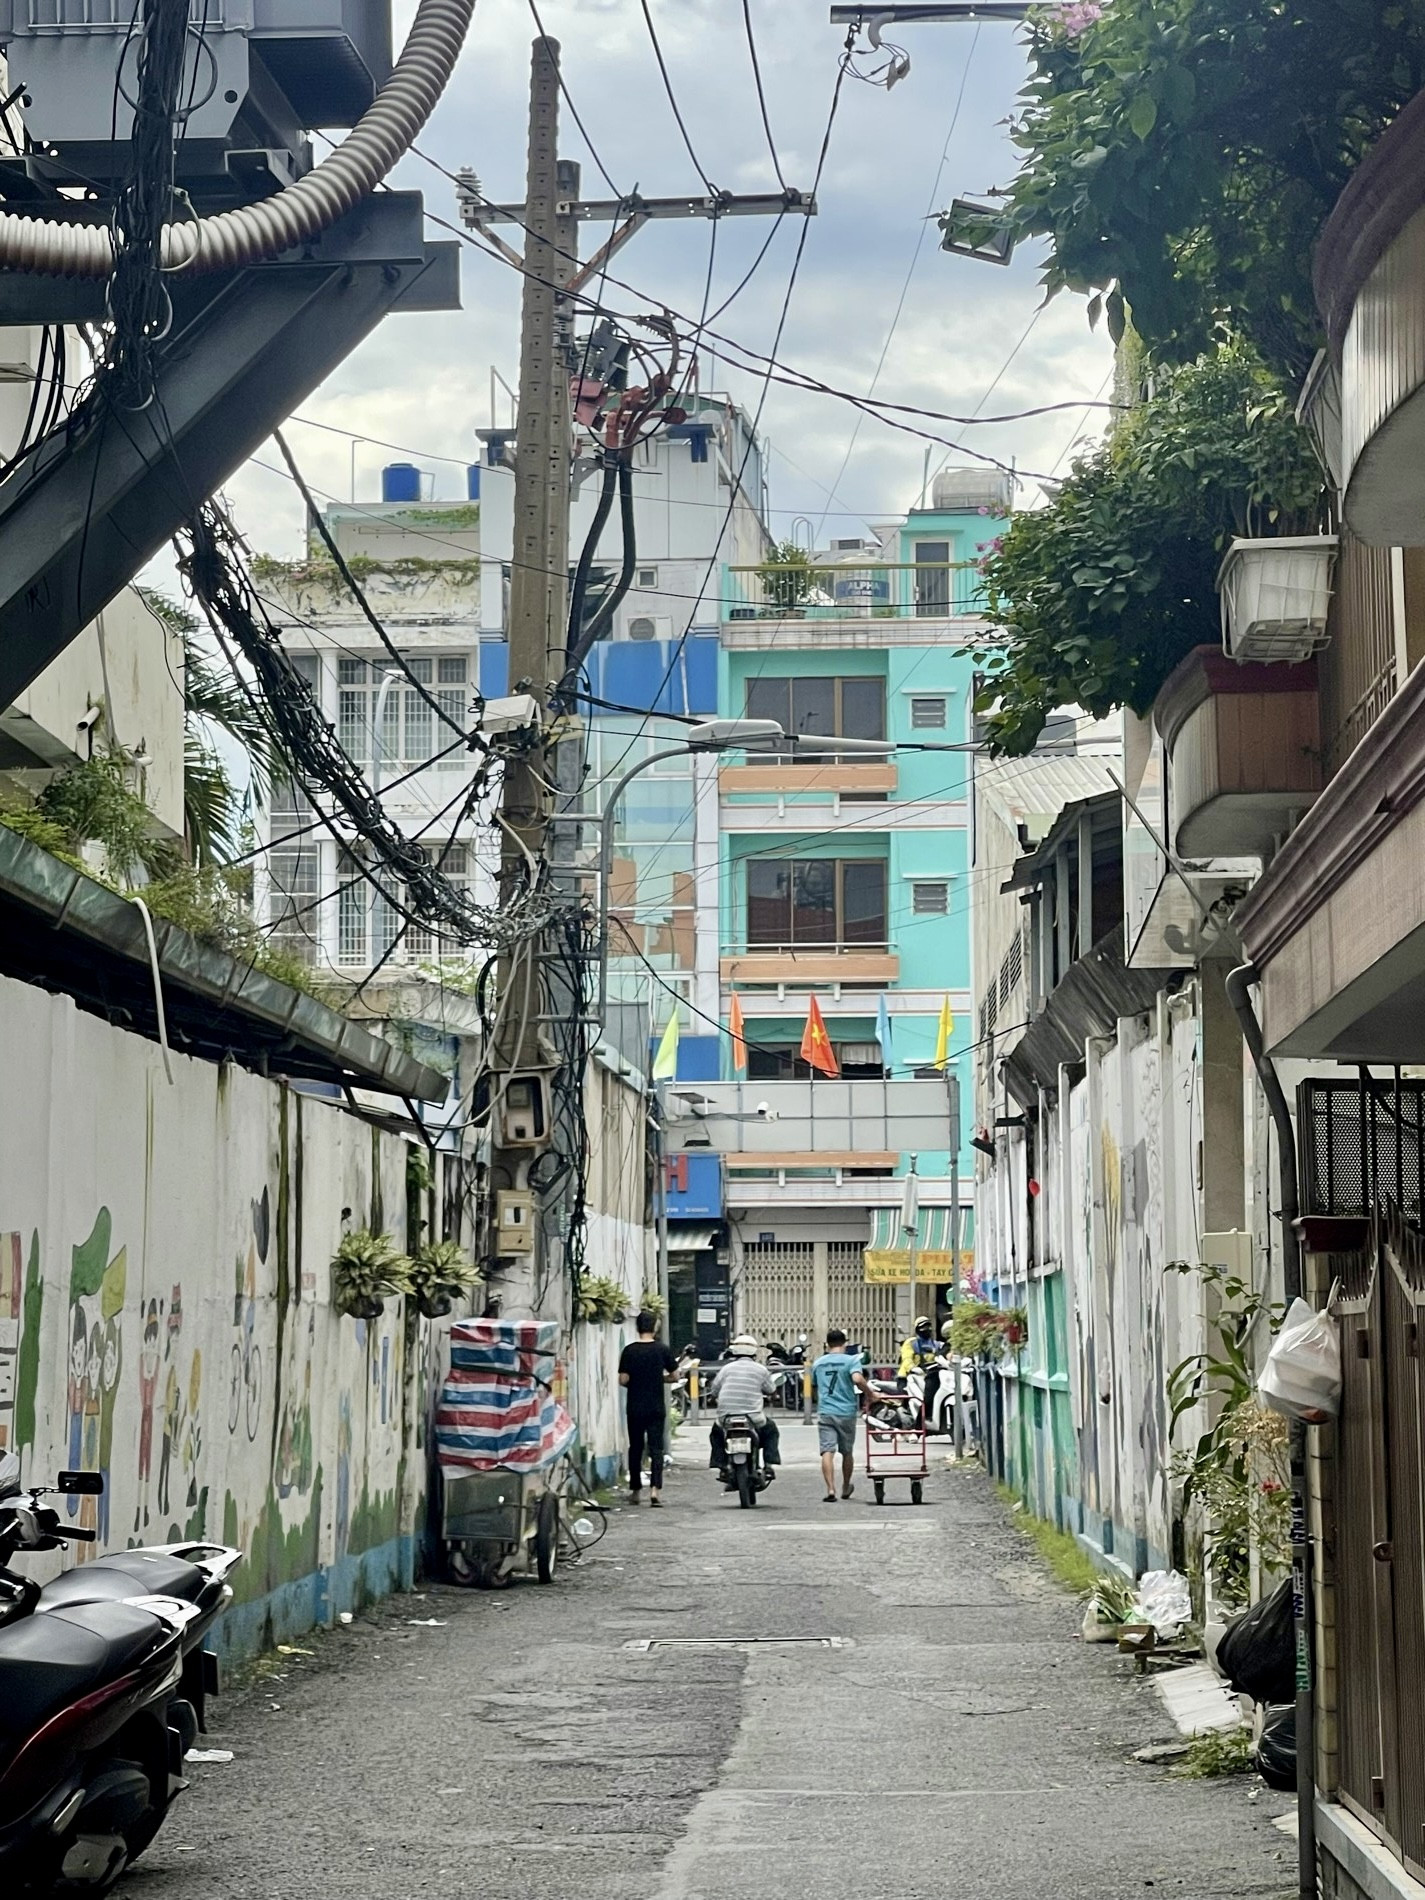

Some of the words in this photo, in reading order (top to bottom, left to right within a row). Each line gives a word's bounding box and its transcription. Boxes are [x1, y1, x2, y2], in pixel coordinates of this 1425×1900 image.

[848, 581, 880, 590] ALPHA
[888, 1268, 897, 1277] XE
[900, 1268, 925, 1277] HODA
[932, 1268, 947, 1277] TAY
[825, 1371, 838, 1395] 7
